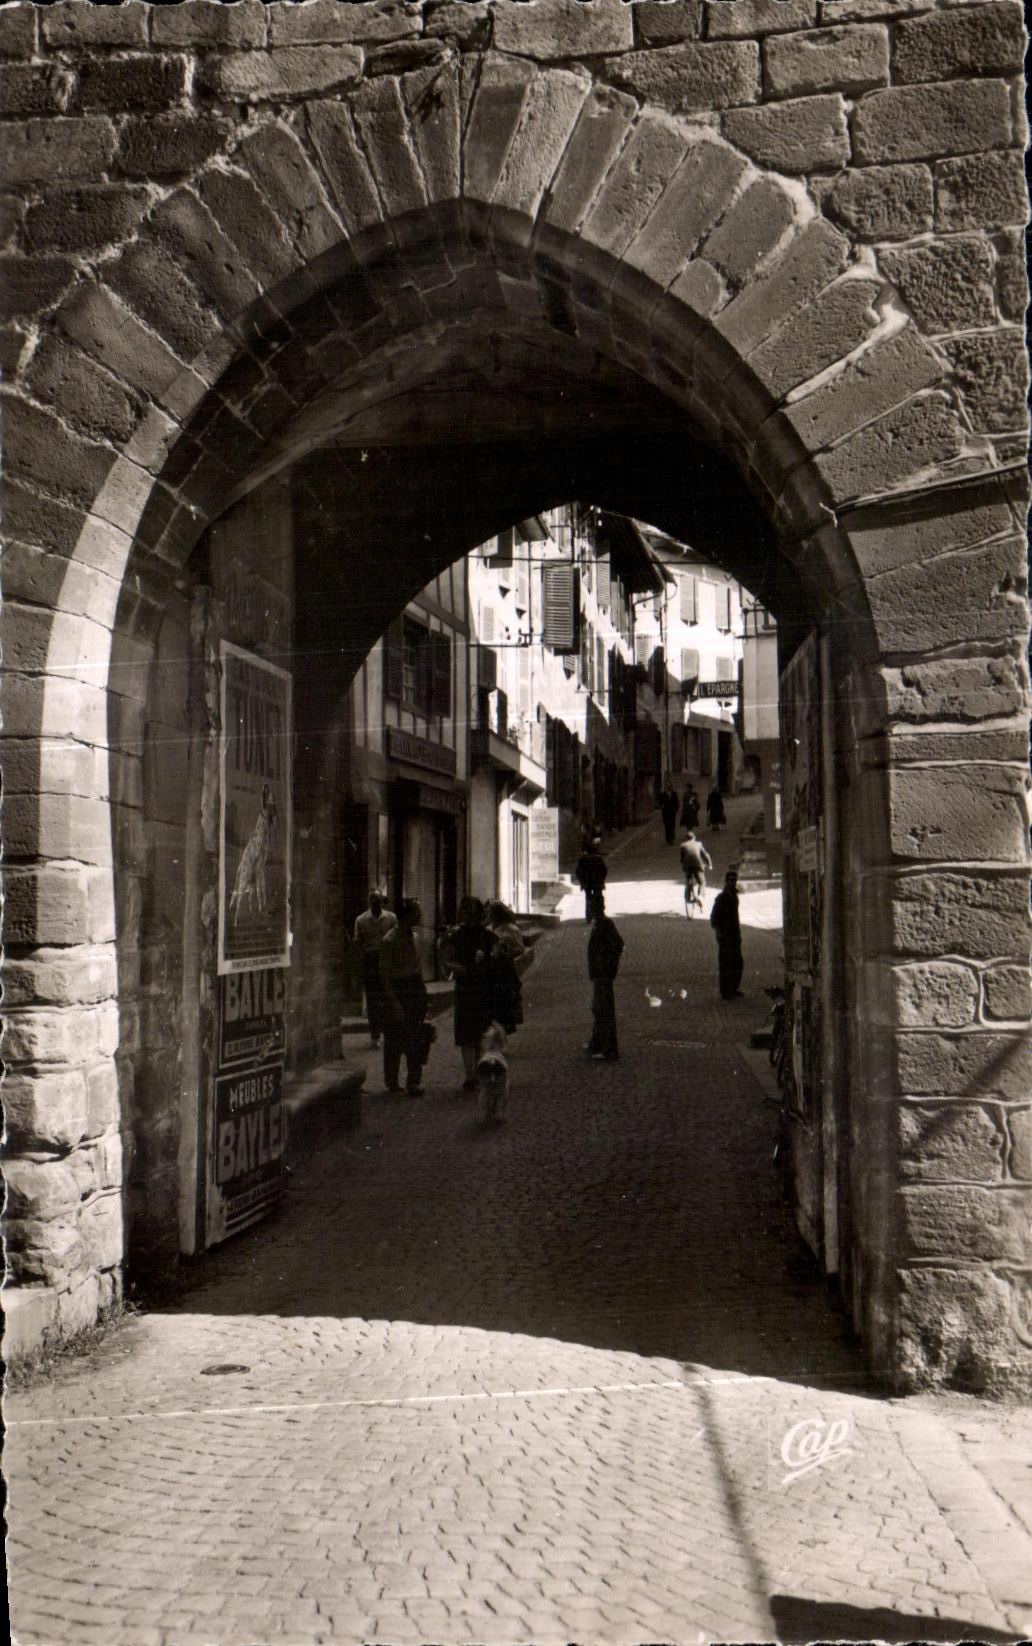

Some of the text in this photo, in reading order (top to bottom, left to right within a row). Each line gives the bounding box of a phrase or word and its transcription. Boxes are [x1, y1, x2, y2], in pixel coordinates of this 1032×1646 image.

[225, 968, 286, 1022] BAYLE
[229, 1074, 275, 1111] MEUBLES
[217, 1103, 282, 1184] BAYLE
